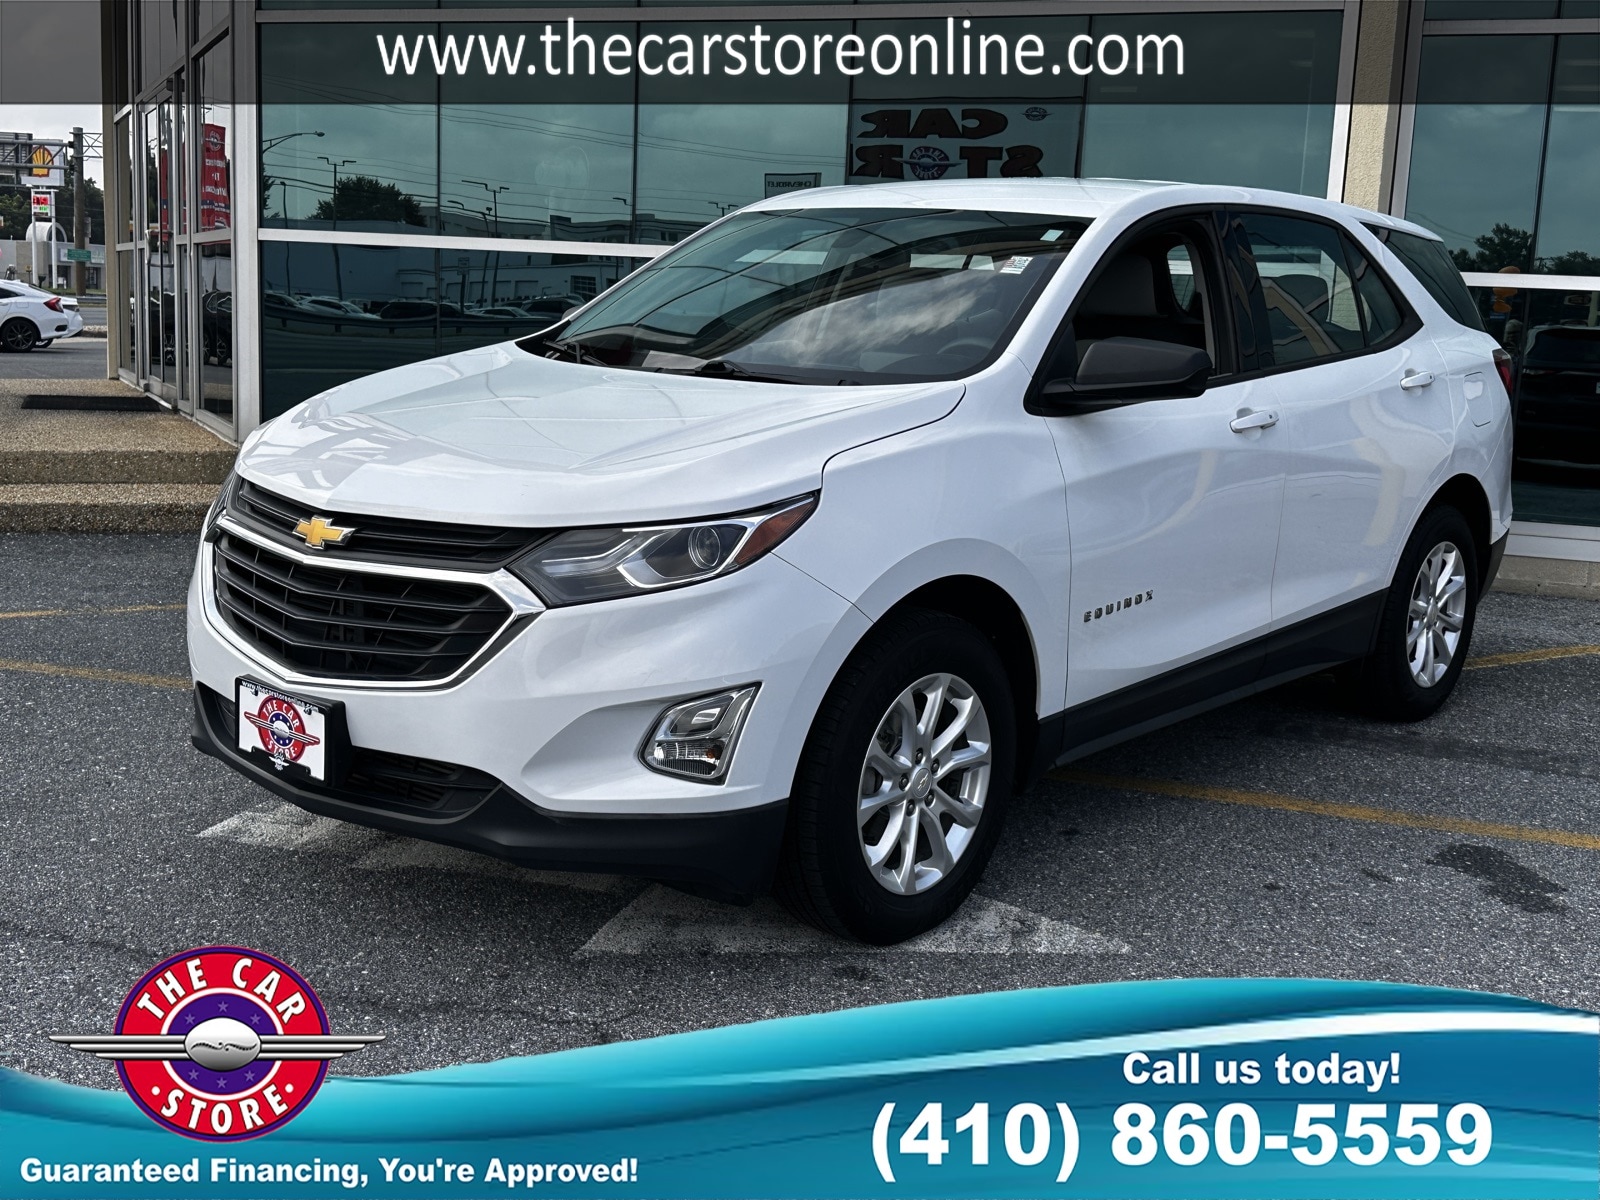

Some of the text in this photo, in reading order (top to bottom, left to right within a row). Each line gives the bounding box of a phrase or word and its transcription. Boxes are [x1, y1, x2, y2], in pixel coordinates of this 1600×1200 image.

[1083, 589, 1154, 623] EQUINOX
[262, 699, 300, 728] THE CAR
